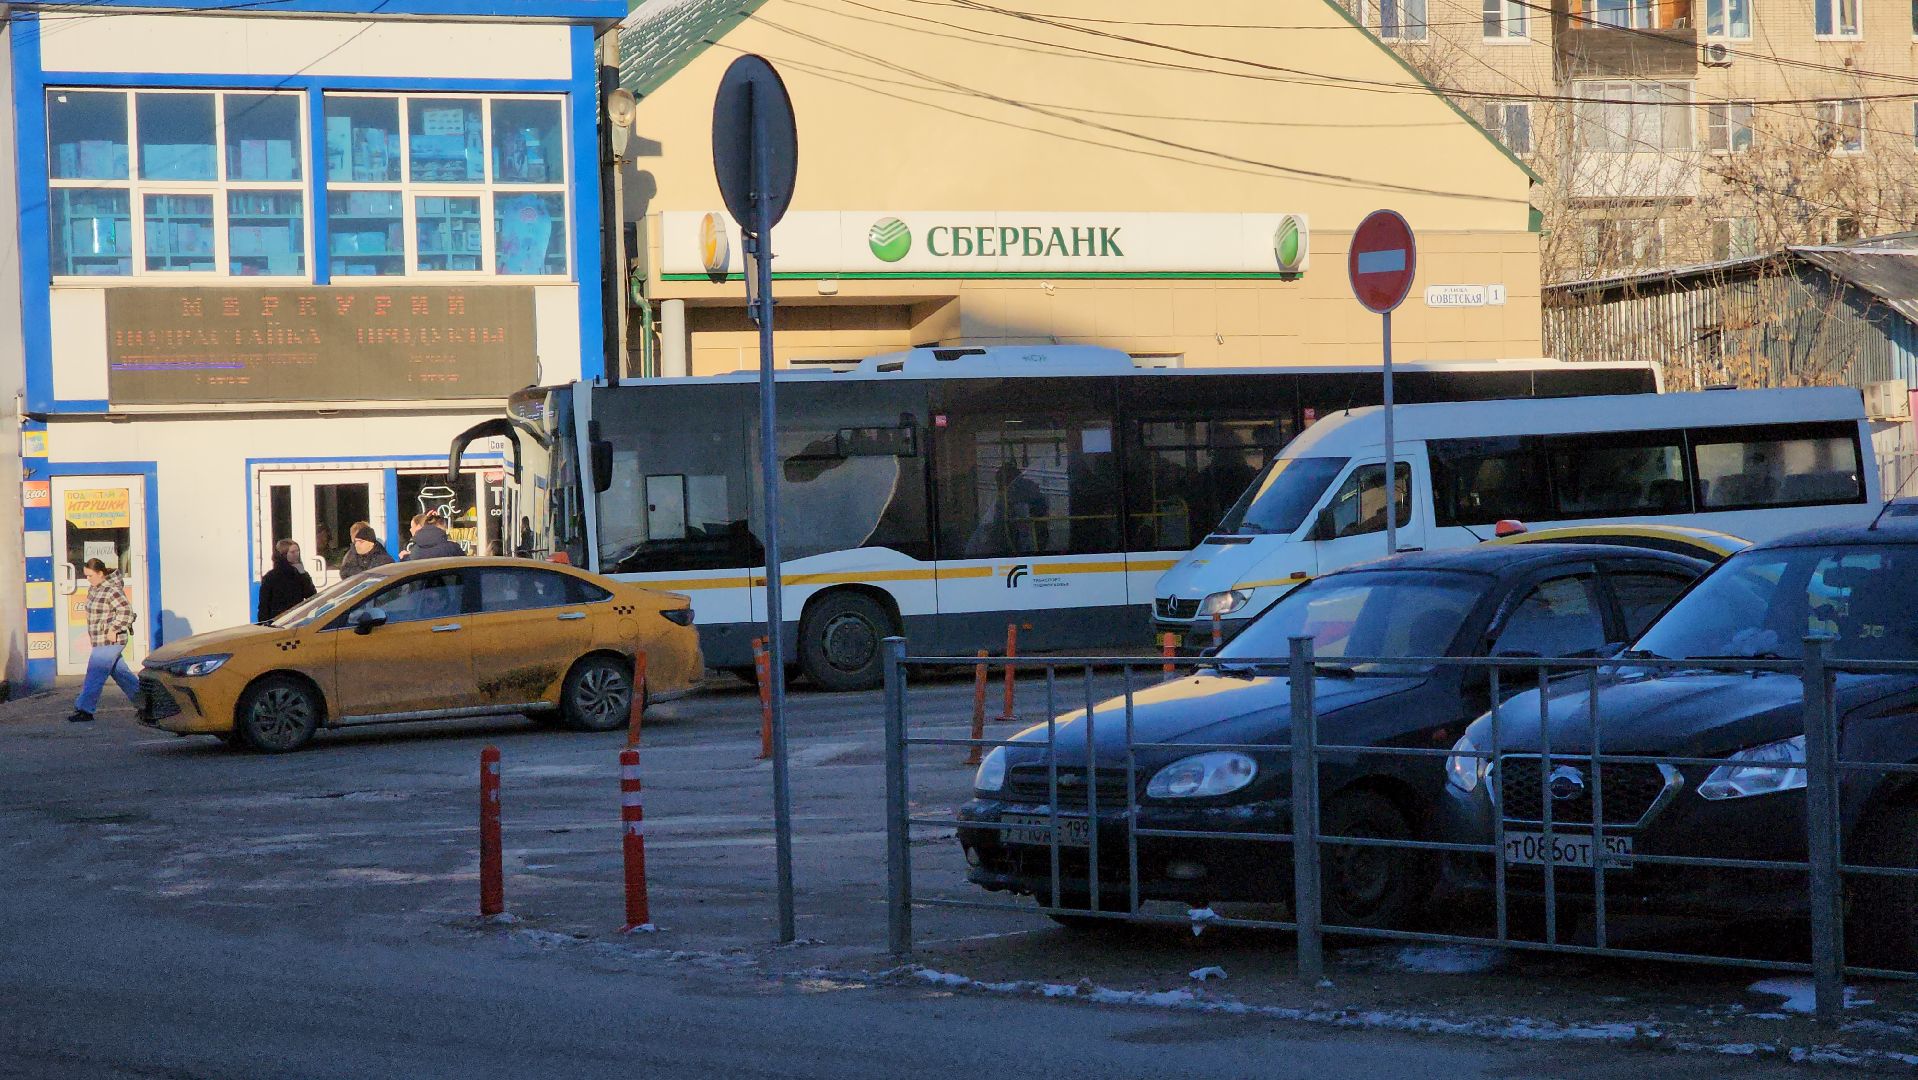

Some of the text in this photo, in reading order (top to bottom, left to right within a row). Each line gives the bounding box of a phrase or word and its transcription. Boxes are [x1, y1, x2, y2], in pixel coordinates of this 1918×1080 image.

[927, 226, 1125, 257] СБЕРБАНК
[1430, 293, 1482, 304] СОВЕТСКАЯ
[1493, 289, 1499, 300] 1
[182, 288, 465, 316] МЕРКУРИЙ
[25, 488, 48, 499] LEGO
[68, 500, 126, 511] ИГРУШКИ
[29, 640, 52, 650] LEGO
